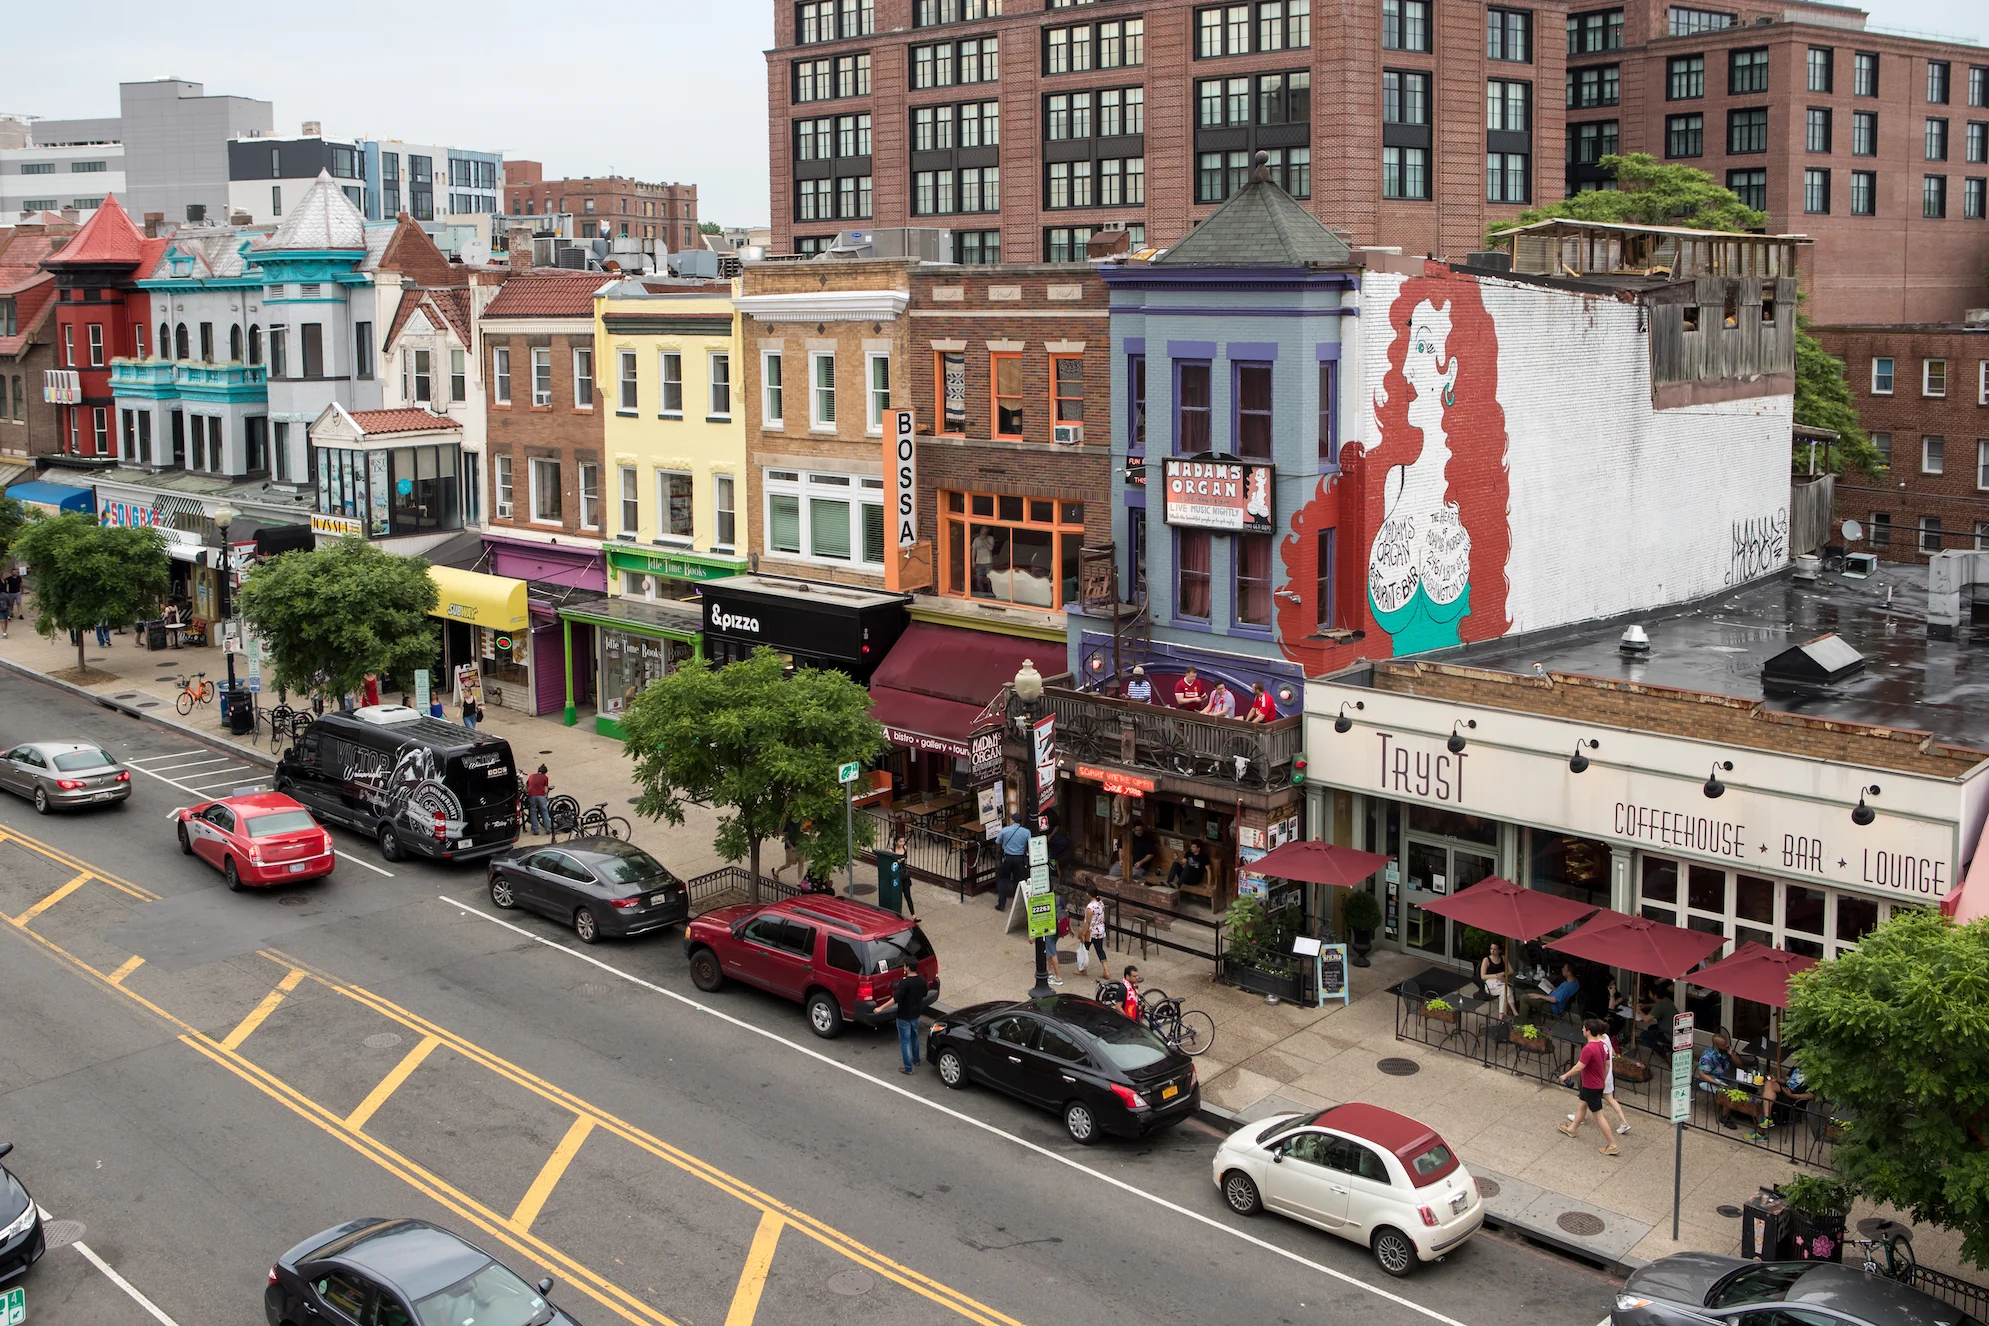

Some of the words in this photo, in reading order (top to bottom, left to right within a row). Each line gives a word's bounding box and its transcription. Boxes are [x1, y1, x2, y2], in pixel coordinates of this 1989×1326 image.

[897, 413, 915, 543] BOSSA
[1167, 461, 1241, 480] MADAM'S
[1171, 478, 1237, 498] ORGAN
[1170, 503, 1188, 512] LIVE
[1190, 505, 1211, 515] MUSIC
[1212, 506, 1240, 517] NIGHTLY
[1376, 540, 1411, 568] ORGAN
[647, 557, 663, 571] Idle
[664, 558, 683, 574] Time
[683, 562, 707, 577] Books
[1401, 566, 1419, 600] BAR
[447, 603, 478, 620] SUBWAY
[711, 603, 760, 633] &pizza
[605, 636, 620, 651] Idle
[621, 638, 640, 654] Time
[641, 643, 662, 658] Books
[893, 731, 914, 743] bistro
[921, 739, 947, 752] gallery
[337, 739, 390, 780] VICTOR
[461, 751, 500, 770] VICTOR
[972, 745, 1002, 766] ORGAN
[343, 763, 391, 787] Wainwright
[1078, 766, 1105, 779] SORRY
[1131, 778, 1155, 789] OPEN
[1376, 731, 1469, 804] TRYST
[1614, 802, 1746, 859] COFFEEHOUSE
[1781, 833, 1824, 874] BAR
[1863, 848, 1946, 897] LOUNGE
